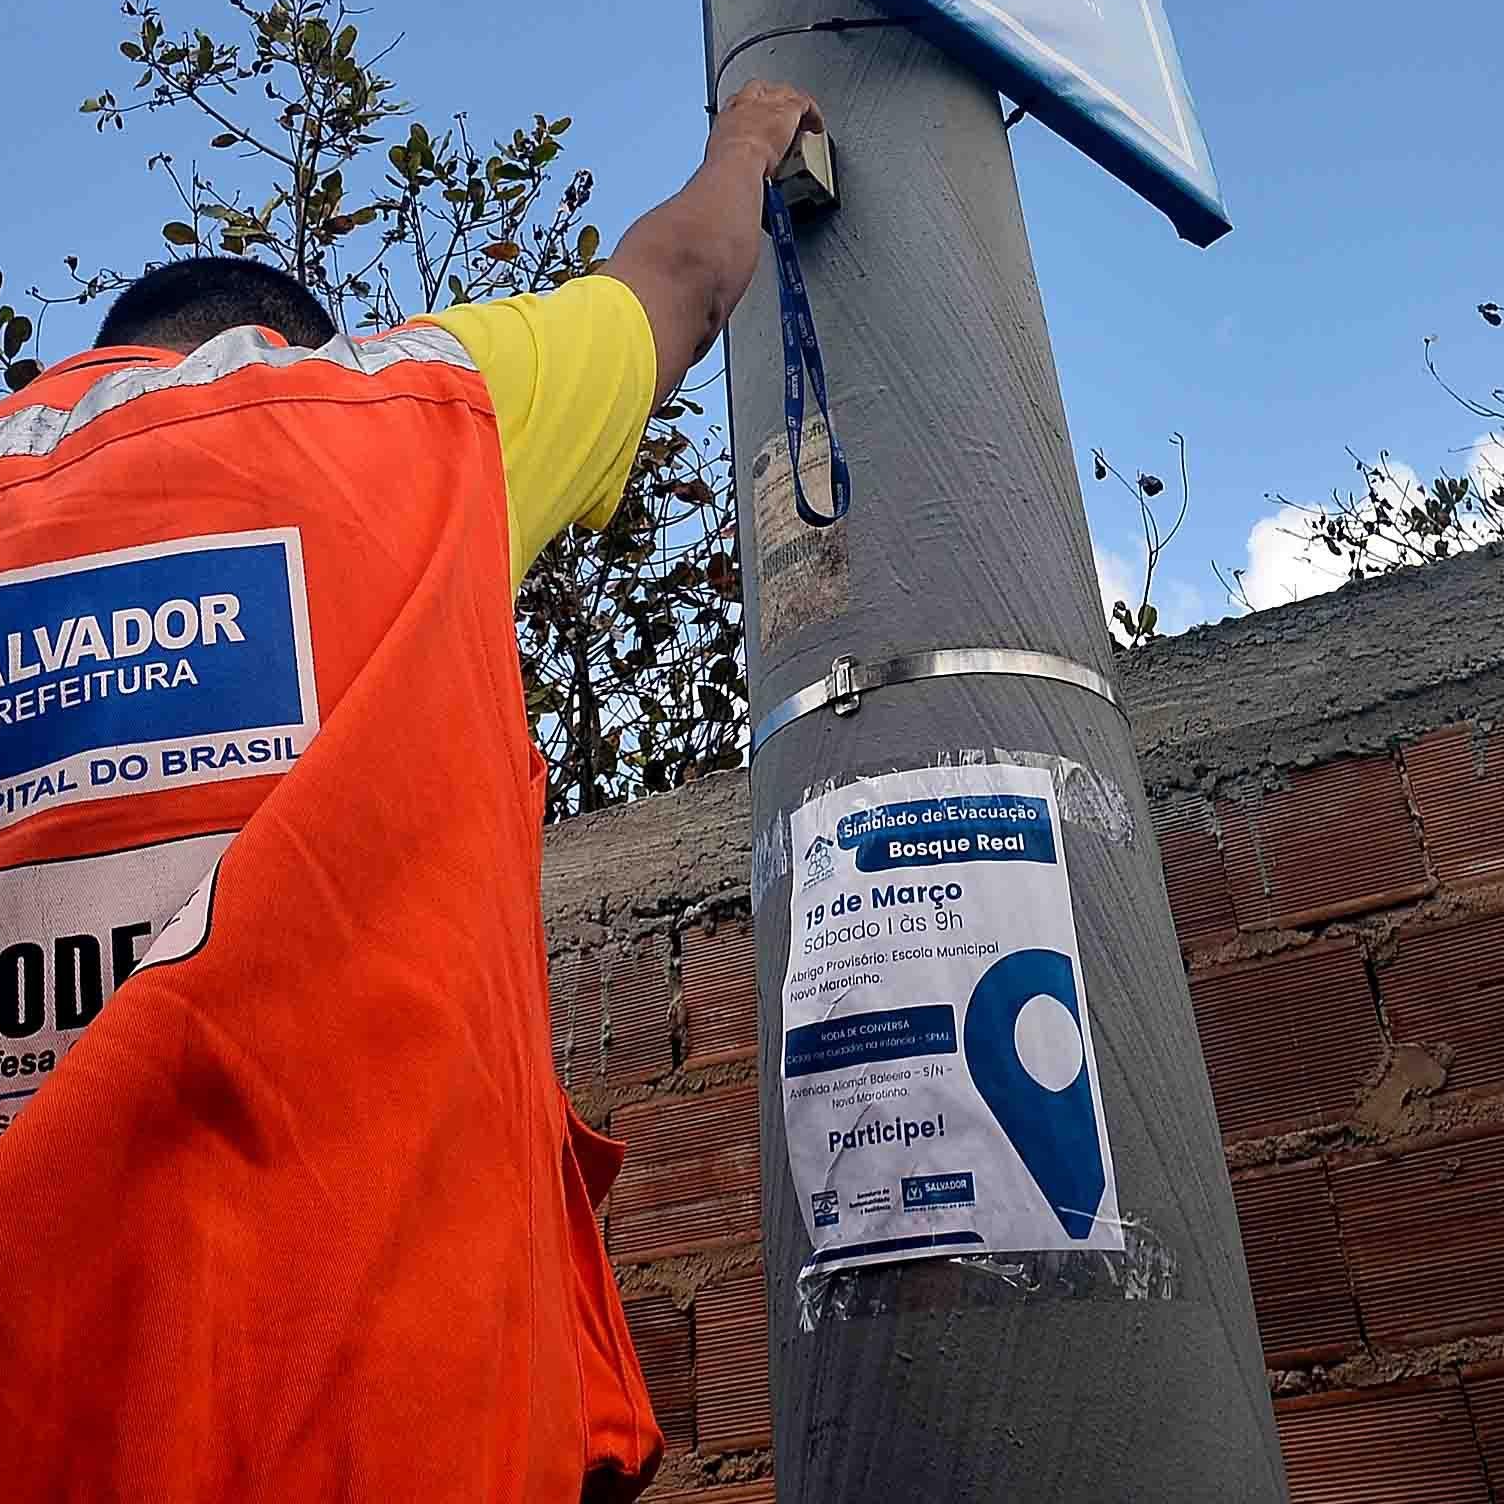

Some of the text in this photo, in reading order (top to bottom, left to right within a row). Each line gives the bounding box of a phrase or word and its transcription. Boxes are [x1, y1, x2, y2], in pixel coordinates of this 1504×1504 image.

[90, 754, 149, 785] DO
[162, 736, 302, 775] BRASIL
[844, 805, 1037, 838] Simulado de Evacuação
[889, 833, 1025, 859] Bosque Real
[805, 882, 963, 930] 19 de Março
[804, 920, 880, 955] sábado
[900, 914, 927, 933] às
[935, 910, 964, 931] 9h
[790, 941, 999, 985] Abrigo Provisório: Escola Municipal
[790, 973, 883, 1003] Novo Marotinho.
[828, 1113, 945, 1152] Participe!
[925, 1179, 967, 1192] SALVADOR
